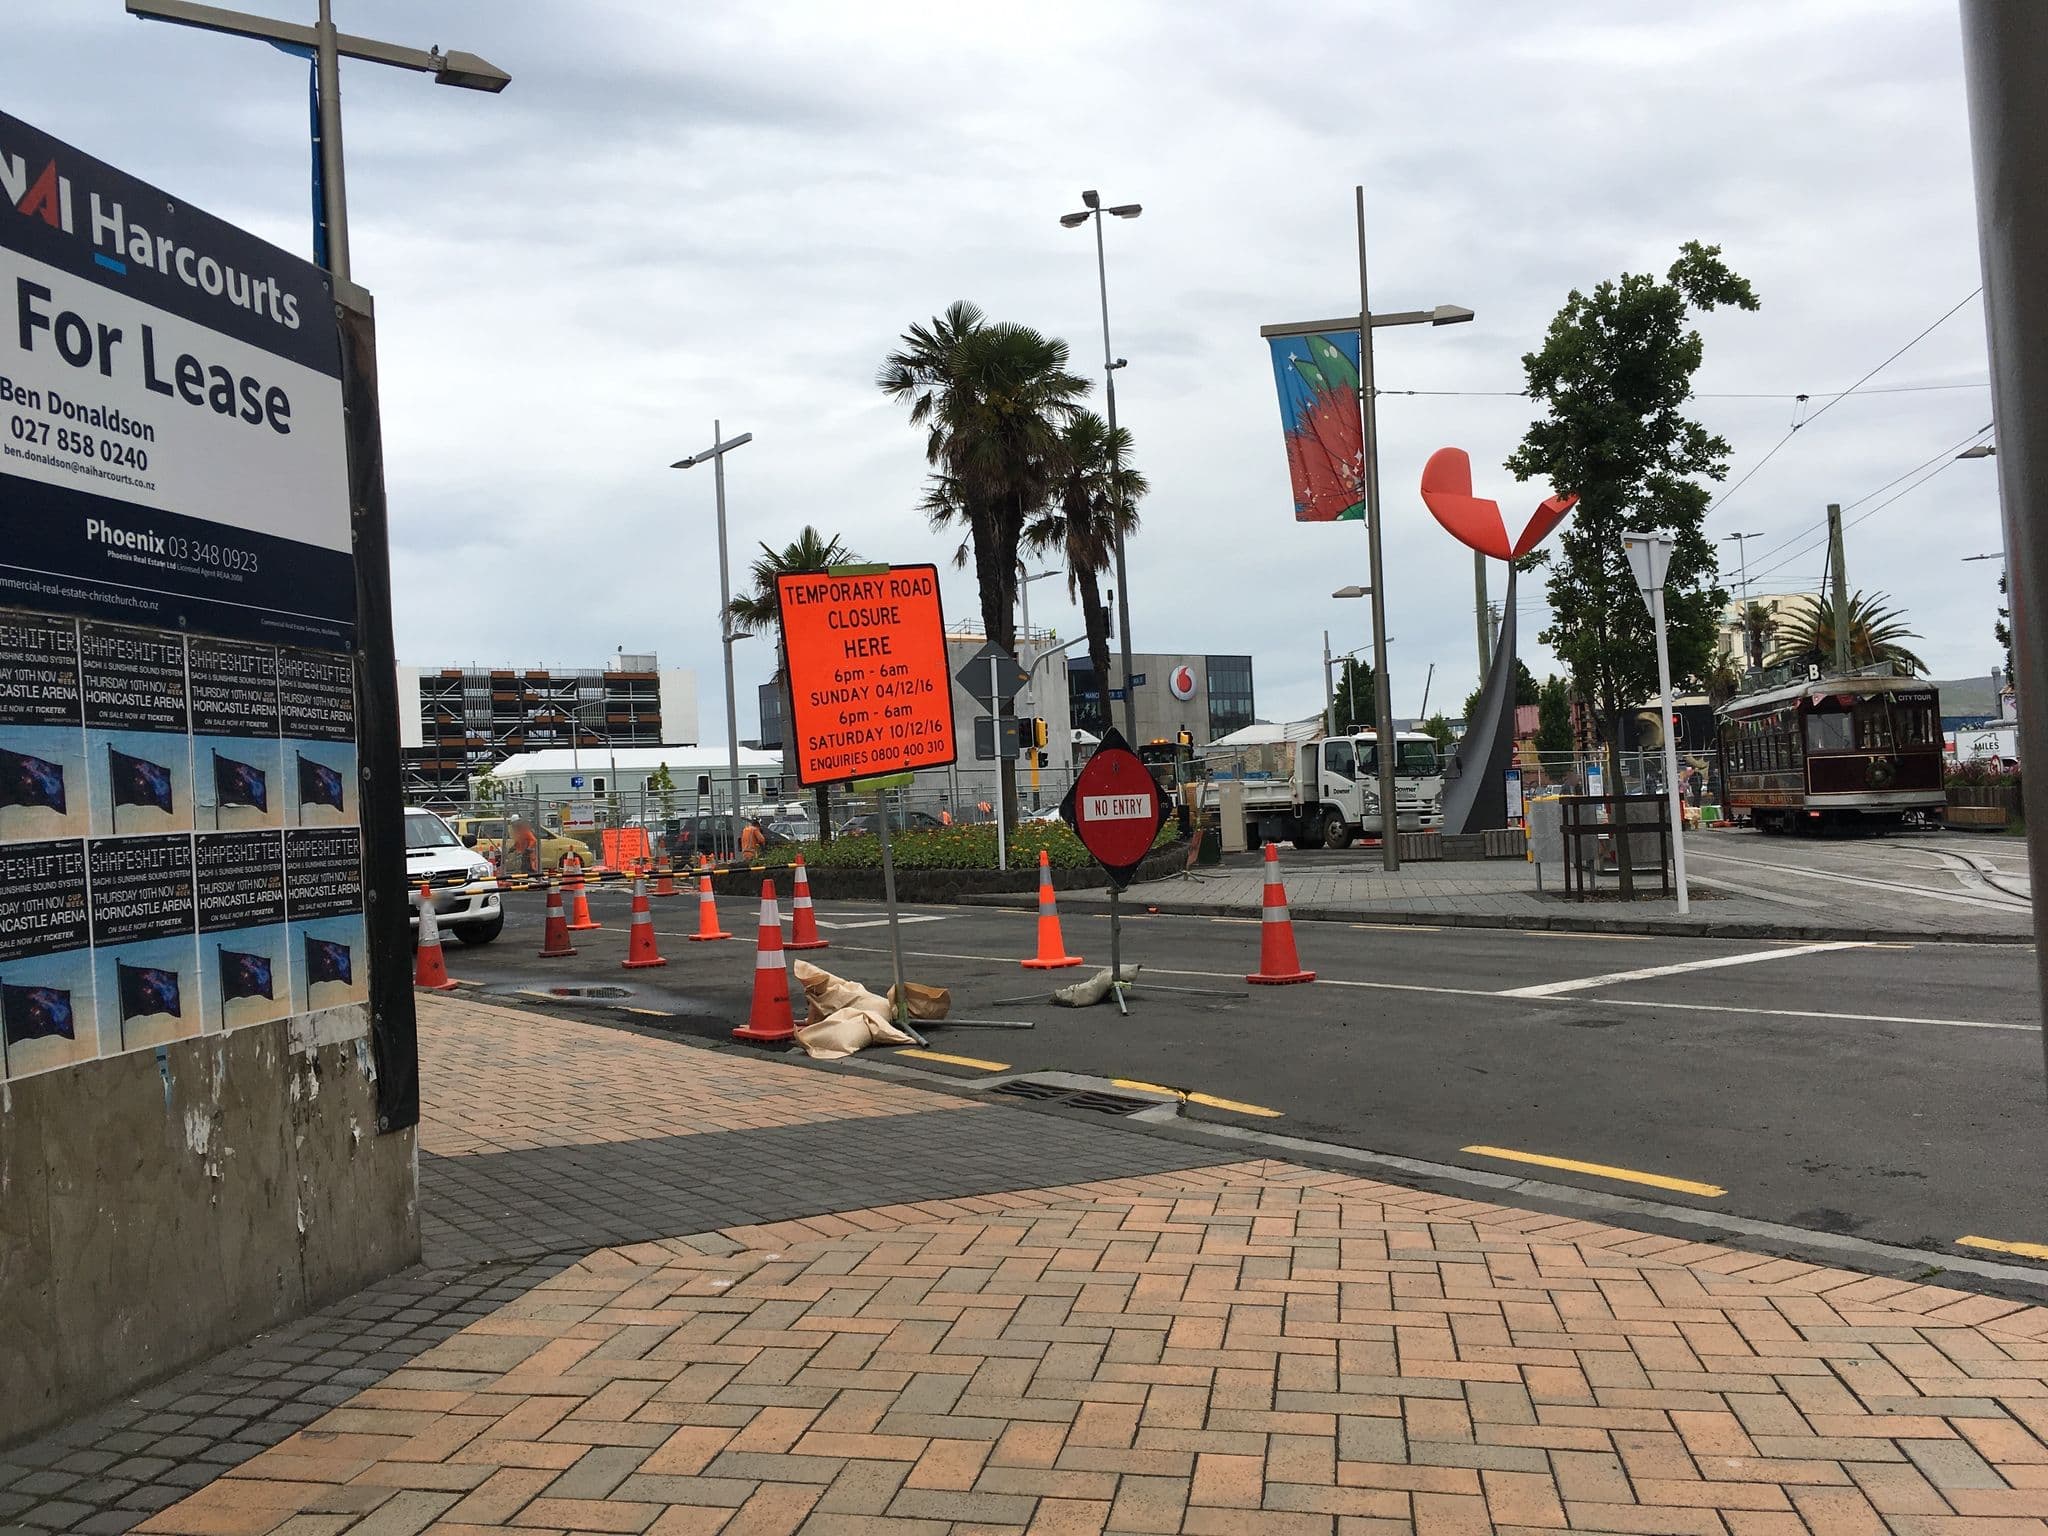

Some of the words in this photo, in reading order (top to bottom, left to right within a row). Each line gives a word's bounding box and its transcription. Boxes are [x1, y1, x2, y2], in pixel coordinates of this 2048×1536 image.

[0, 150, 73, 234] NAI
[90, 193, 300, 330] Harcourts
[17, 277, 122, 377] For
[142, 323, 291, 434] Lease
[0, 376, 40, 411] Ben
[48, 390, 155, 442] Donaldson
[11, 415, 50, 446] 027
[57, 428, 95, 458] 858
[101, 439, 148, 472] 0240
[4, 443, 156, 490] ben.donaldson@naiharcourts.co.nz
[87, 518, 165, 555] Phoenix
[168, 536, 188, 559] 03
[191, 541, 220, 565] 348
[222, 547, 258, 573] 0923
[107, 550, 132, 561] Phoenix
[133, 555, 147, 564] Real
[147, 557, 165, 568] Estate
[166, 561, 176, 570] Ltd
[785, 581, 884, 605] TEMPORARY
[890, 578, 932, 598] ROAD
[828, 606, 900, 629] CLOSURE
[81, 635, 183, 664] SHAPESHIFTER
[844, 636, 892, 659] HERE
[189, 650, 276, 676] SHAPESHIFTER
[1808, 663, 1820, 680] B
[1906, 659, 1913, 674] B
[14, 668, 37, 681] 10TH
[38, 669, 58, 682] NOV
[84, 675, 129, 690] THURSDAY
[129, 679, 149, 691] 10TH
[150, 681, 167, 693] NOV
[834, 669, 864, 685] 6pm
[880, 664, 908, 677] 6am
[42, 686, 79, 700] ARENA
[86, 690, 152, 707] HORNCASTLE
[153, 696, 185, 709] ARENA
[191, 686, 230, 699] THURSDAY
[231, 689, 247, 700] 10TH
[248, 691, 262, 701] NOV
[811, 687, 869, 706] SUNDAY
[876, 679, 933, 698] 04/12/16
[193, 700, 250, 714] HORNCASTLE
[251, 704, 277, 716] ARENA
[839, 711, 869, 727] 6pm
[884, 703, 912, 719] 6am
[809, 727, 883, 750] SATURDAY
[890, 719, 943, 739] 10/12/16
[811, 752, 868, 771] ENQUIRIES
[872, 746, 899, 762] 0800
[903, 743, 924, 757] 400
[927, 739, 944, 753] 310
[1974, 741, 1999, 751] MILES
[1095, 799, 1107, 817] NO
[1113, 798, 1142, 816] ENTRY
[197, 842, 281, 865] SHAPESHIFTER
[287, 839, 359, 858] SHAPESHIFTER
[91, 847, 190, 873] SHAPESHIFTER
[93, 889, 137, 905] THURSDAY
[138, 887, 157, 900] 10TH
[158, 886, 175, 898] NOV
[199, 881, 236, 895] THURSDAY
[237, 879, 253, 891] 10TH
[254, 877, 268, 889] NOV
[288, 885, 336, 899] HORNCASTLE
[337, 882, 360, 894] ARENA
[23, 898, 46, 913] 10TH
[46, 896, 66, 910] NOV
[95, 902, 160, 921] HORNCASTLE
[161, 898, 192, 913] ARENA
[200, 893, 256, 910] HORNCASTLE
[257, 889, 283, 903] ARENA
[50, 909, 86, 926] ARENA
[44, 931, 75, 943] TICKETEK
